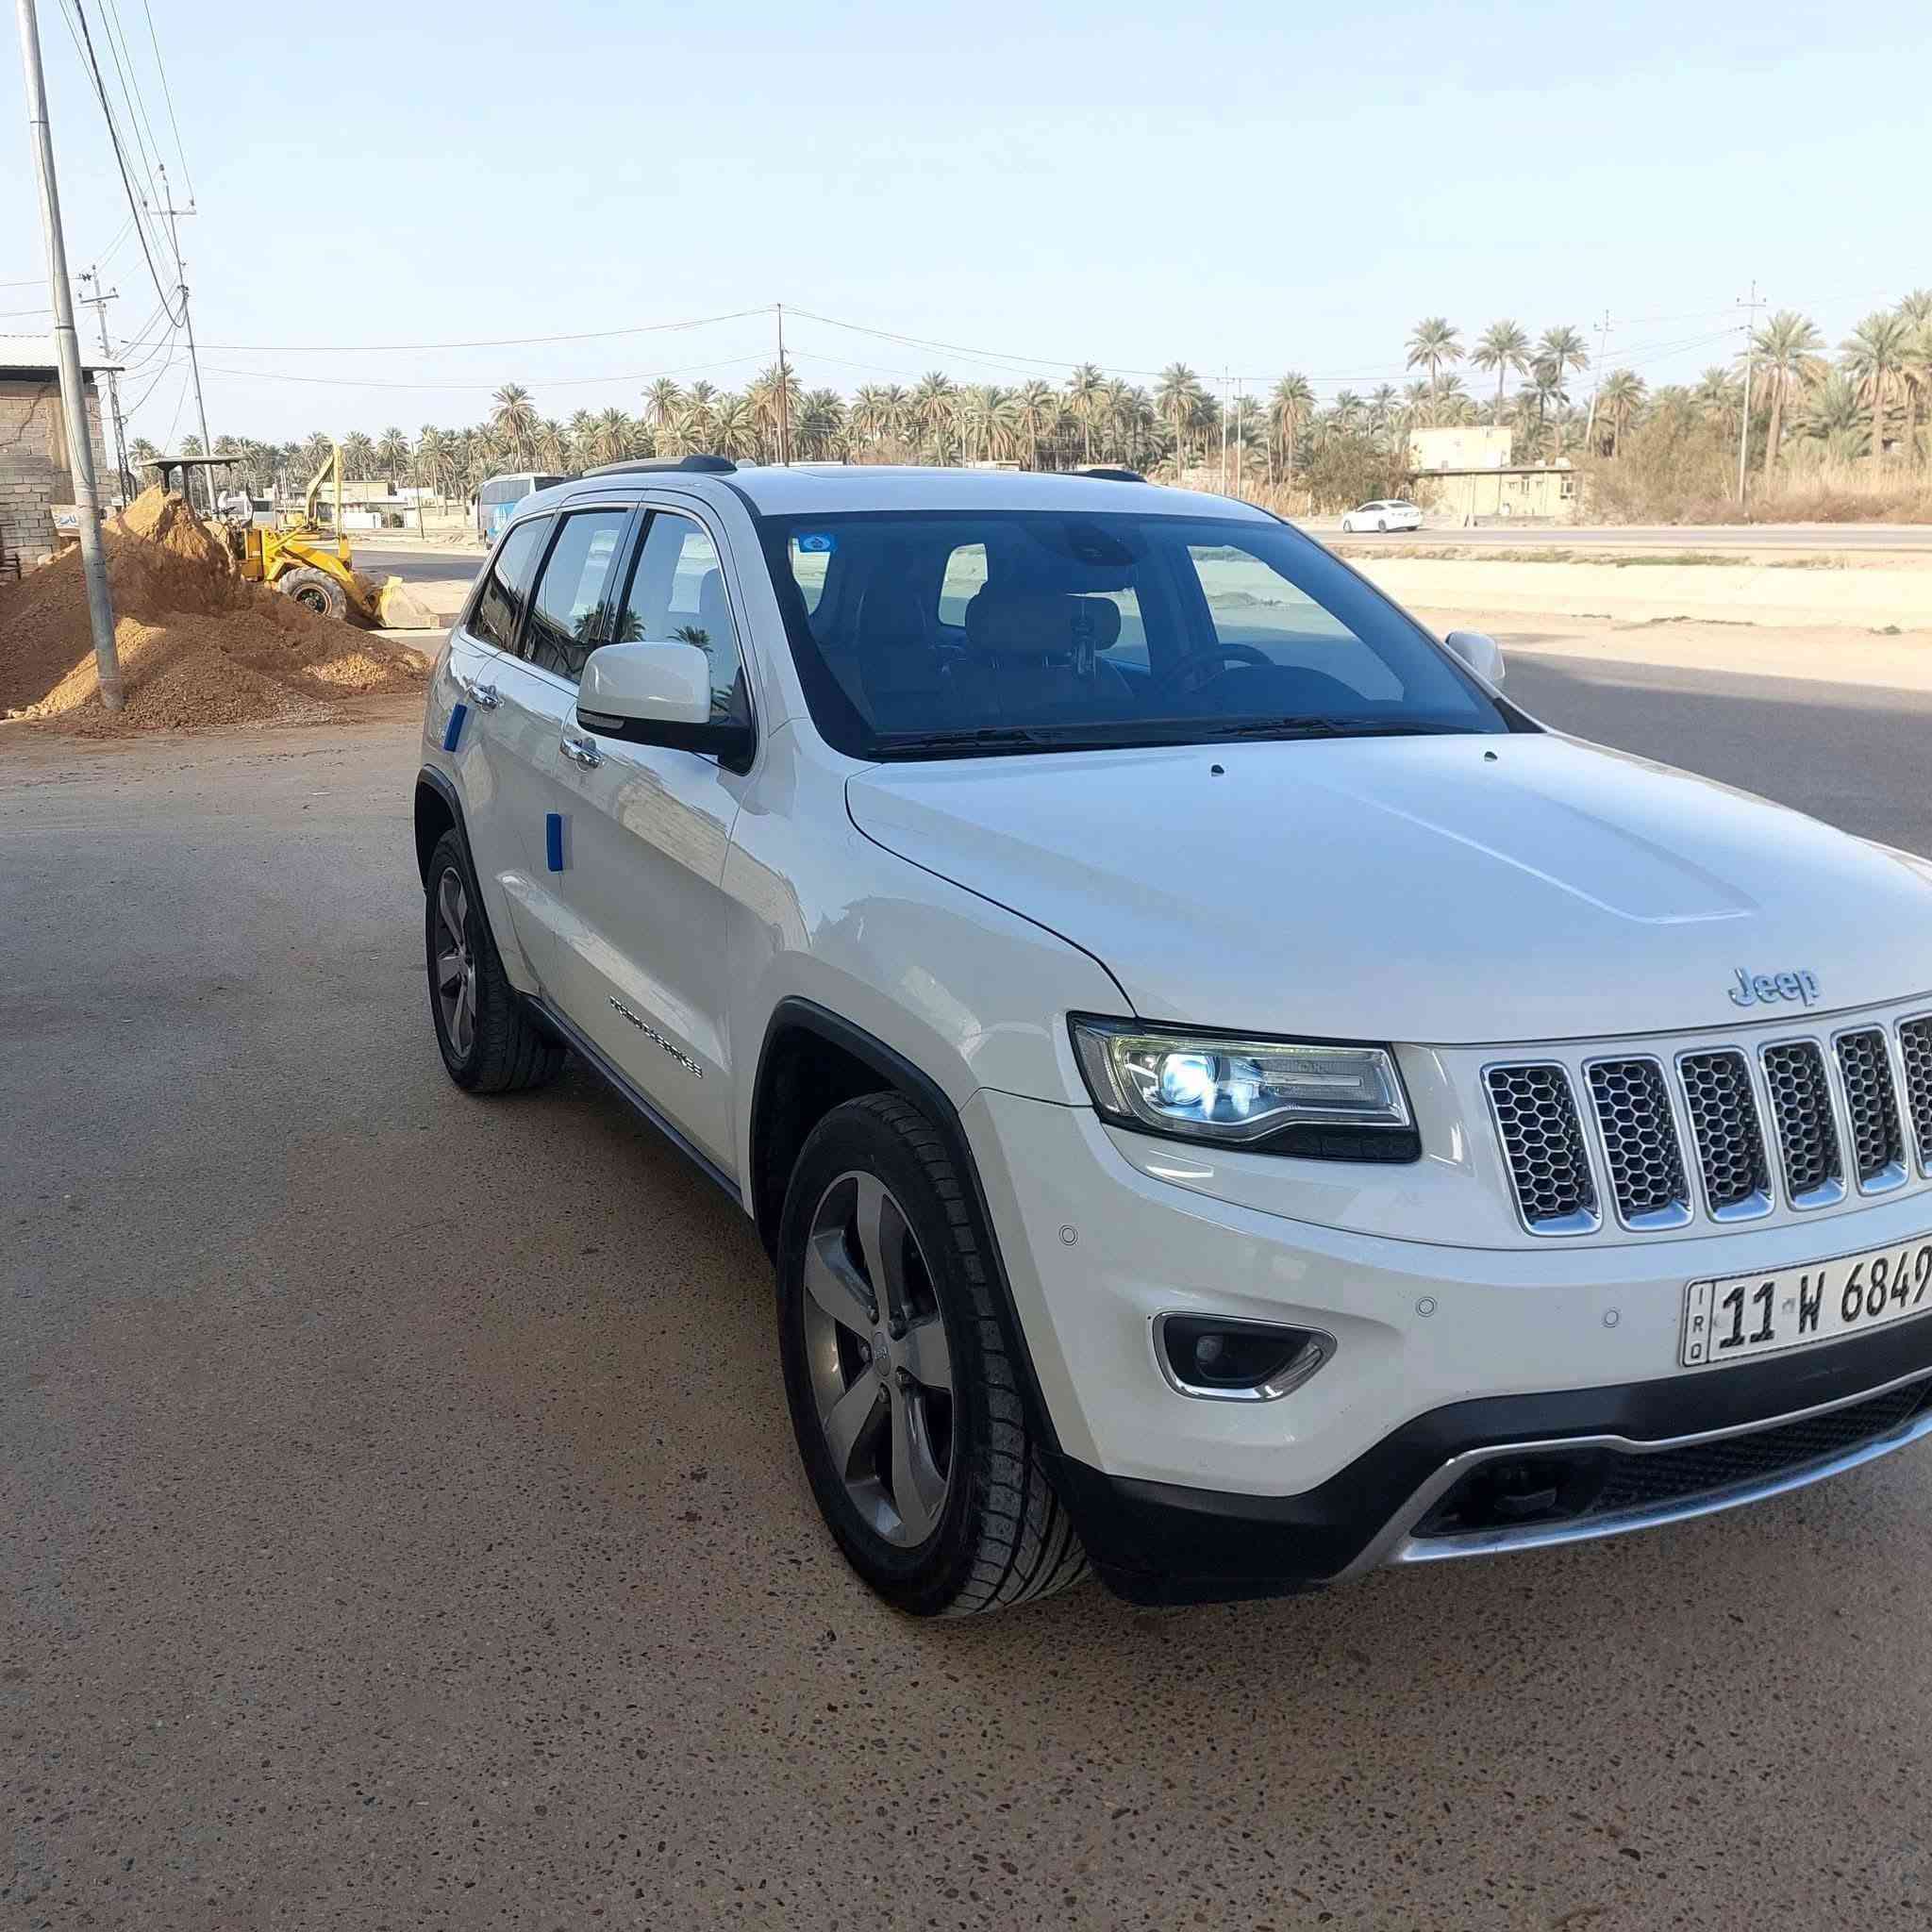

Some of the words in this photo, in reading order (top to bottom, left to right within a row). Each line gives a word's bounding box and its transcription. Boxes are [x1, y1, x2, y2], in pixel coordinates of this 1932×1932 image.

[1727, 967, 1820, 1008] Jeep
[1719, 1281, 1774, 1349] 11
[1798, 1271, 1825, 1333] W
[1841, 1245, 1932, 1323] 6849
